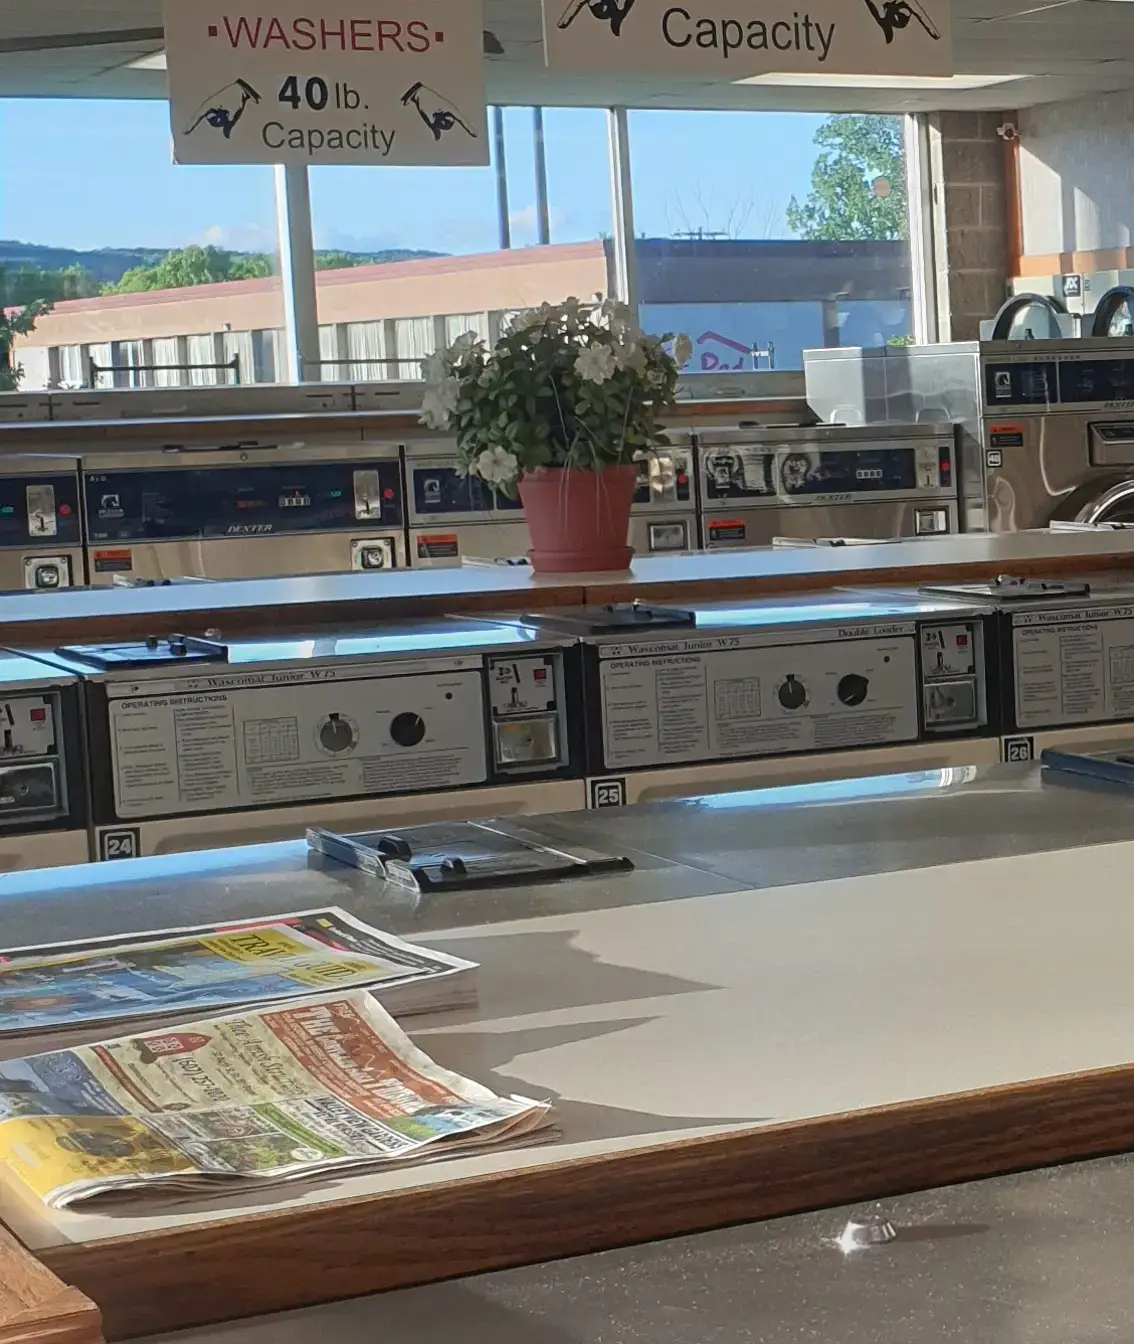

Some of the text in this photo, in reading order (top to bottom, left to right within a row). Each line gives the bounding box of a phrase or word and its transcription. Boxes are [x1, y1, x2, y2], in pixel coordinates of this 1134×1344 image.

[662, 8, 835, 61] Capacity
[279, 76, 368, 110] 40 lb.
[262, 122, 395, 156] Capacity
[838, 624, 904, 638] Double Loader
[628, 642, 679, 654] Wascomat
[683, 639, 713, 652] Junior
[1009, 746, 1028, 760] 26
[598, 790, 618, 804] 25
[107, 839, 131, 855] 24
